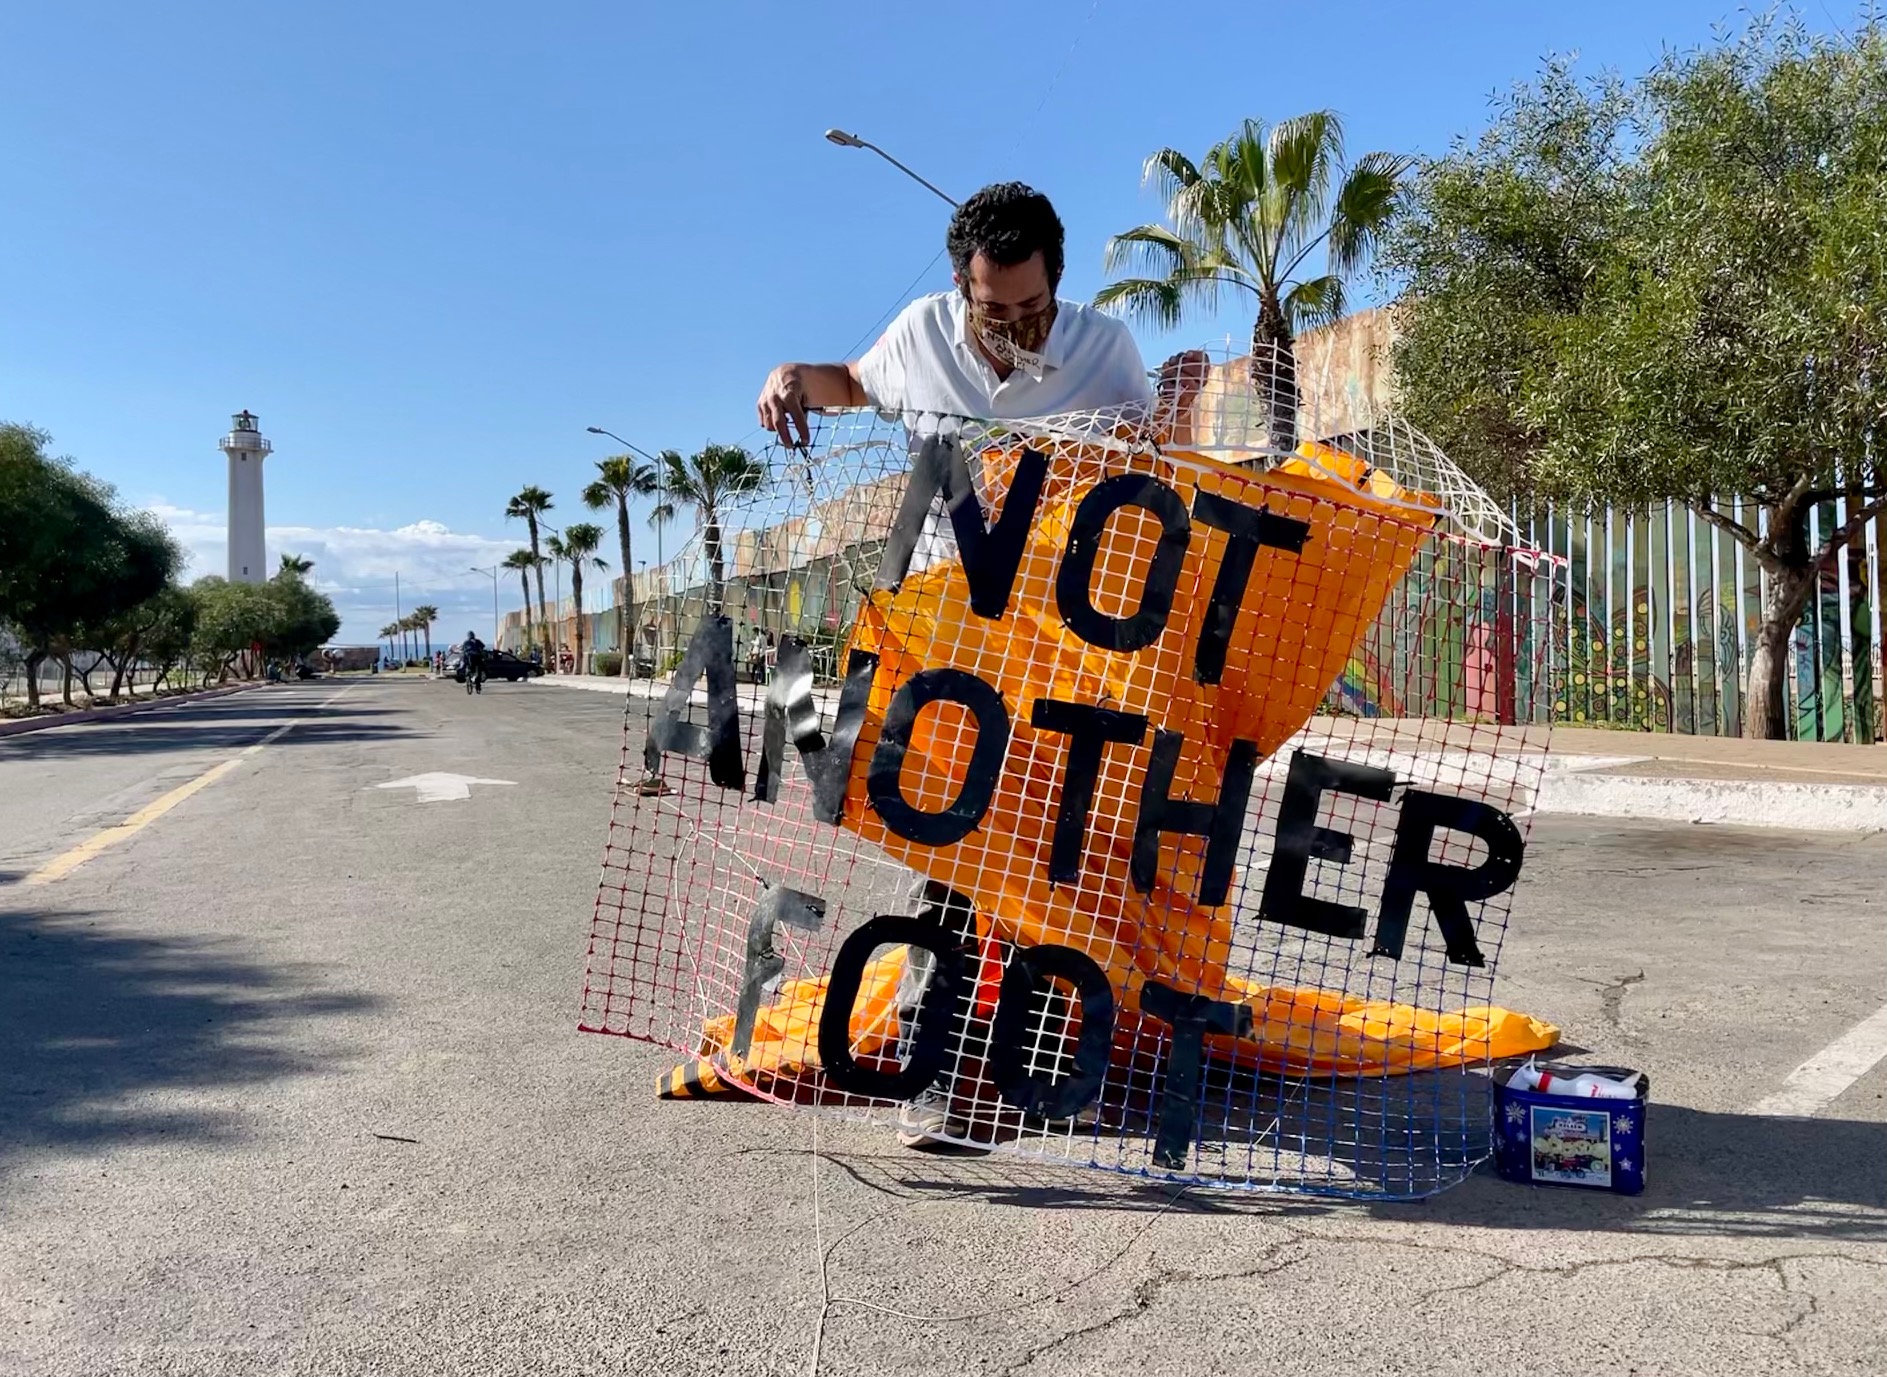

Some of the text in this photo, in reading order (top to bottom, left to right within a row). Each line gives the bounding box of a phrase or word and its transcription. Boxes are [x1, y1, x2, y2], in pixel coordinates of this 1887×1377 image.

[876, 434, 1309, 685] NOT
[645, 616, 1523, 967] ANOTHER
[732, 883, 1253, 1170] FOOT
